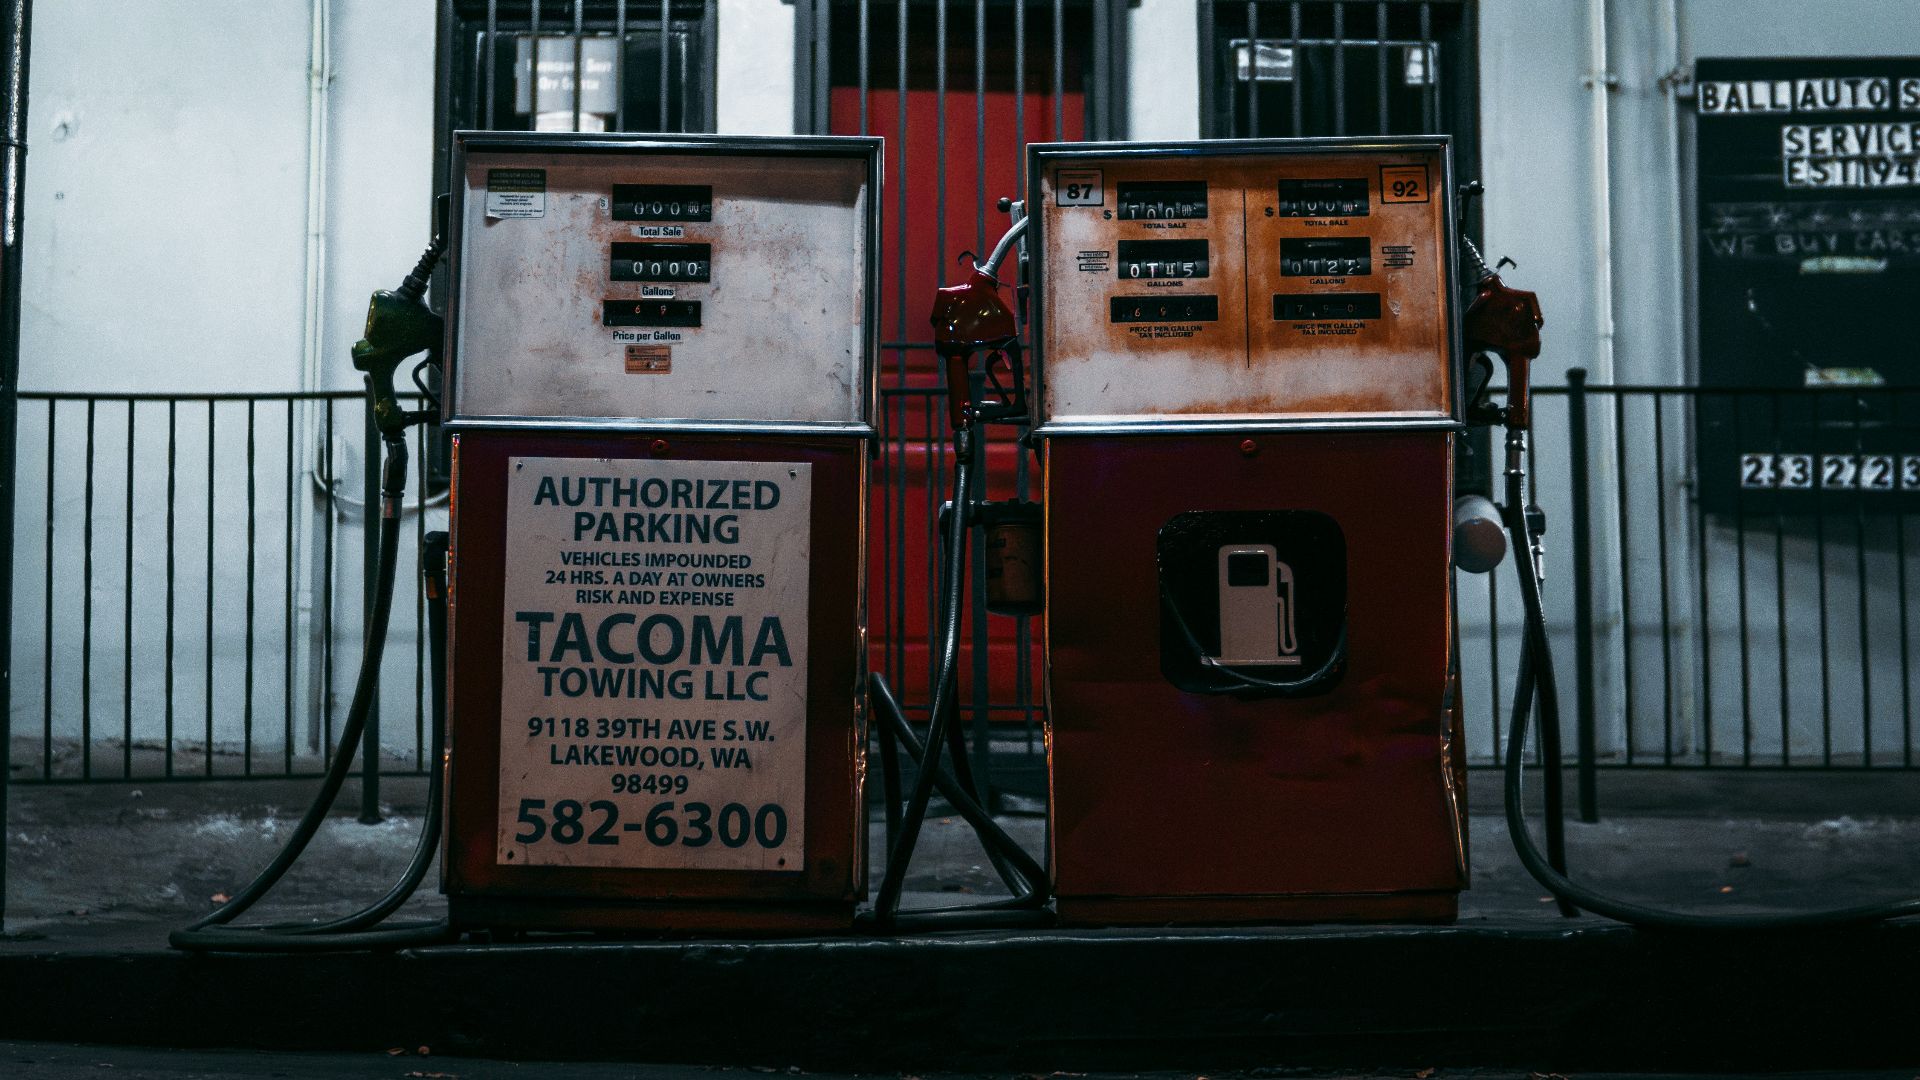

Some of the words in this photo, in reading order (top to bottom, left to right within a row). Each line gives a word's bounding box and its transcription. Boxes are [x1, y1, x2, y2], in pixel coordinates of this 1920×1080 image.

[1702, 82, 1788, 110] BALL
[1801, 80, 1886, 107] AUTO
[1067, 183, 1093, 200] 87
[1392, 181, 1418, 197] 92
[640, 226, 660, 236] Total
[662, 226, 682, 236] Sale
[1774, 233, 1839, 254] BUY
[1147, 280, 1183, 288] GALLONS
[1310, 277, 1346, 285] GALLONS
[642, 287, 674, 297] Gallons
[613, 331, 634, 340] Price
[637, 332, 651, 342] per
[654, 331, 681, 340] Gallon
[534, 477, 780, 510] AUTHORIZED
[574, 512, 739, 544] PARKING
[561, 552, 640, 567] VEHICLES
[645, 553, 751, 569] IMPOUNDED
[546, 570, 566, 584] 24
[571, 571, 608, 585] HRS.
[613, 571, 625, 585] A
[629, 572, 662, 586] DAY
[667, 573, 688, 586] AT
[692, 573, 765, 588] OWNERS
[576, 590, 613, 603] RISK
[617, 590, 655, 605] AND
[660, 591, 733, 606] EXPENSE
[516, 612, 792, 667] TACOMA
[538, 667, 693, 699] TOWING
[705, 671, 769, 701] LLC
[528, 717, 589, 738] 9118
[596, 718, 660, 739] 39TH
[667, 720, 716, 740] AVE
[723, 721, 774, 742] S.W.
[551, 744, 704, 770] LAKEWOOD,
[711, 748, 752, 771] WA
[612, 774, 688, 795] 98499
[516, 799, 787, 848] 582-6300
